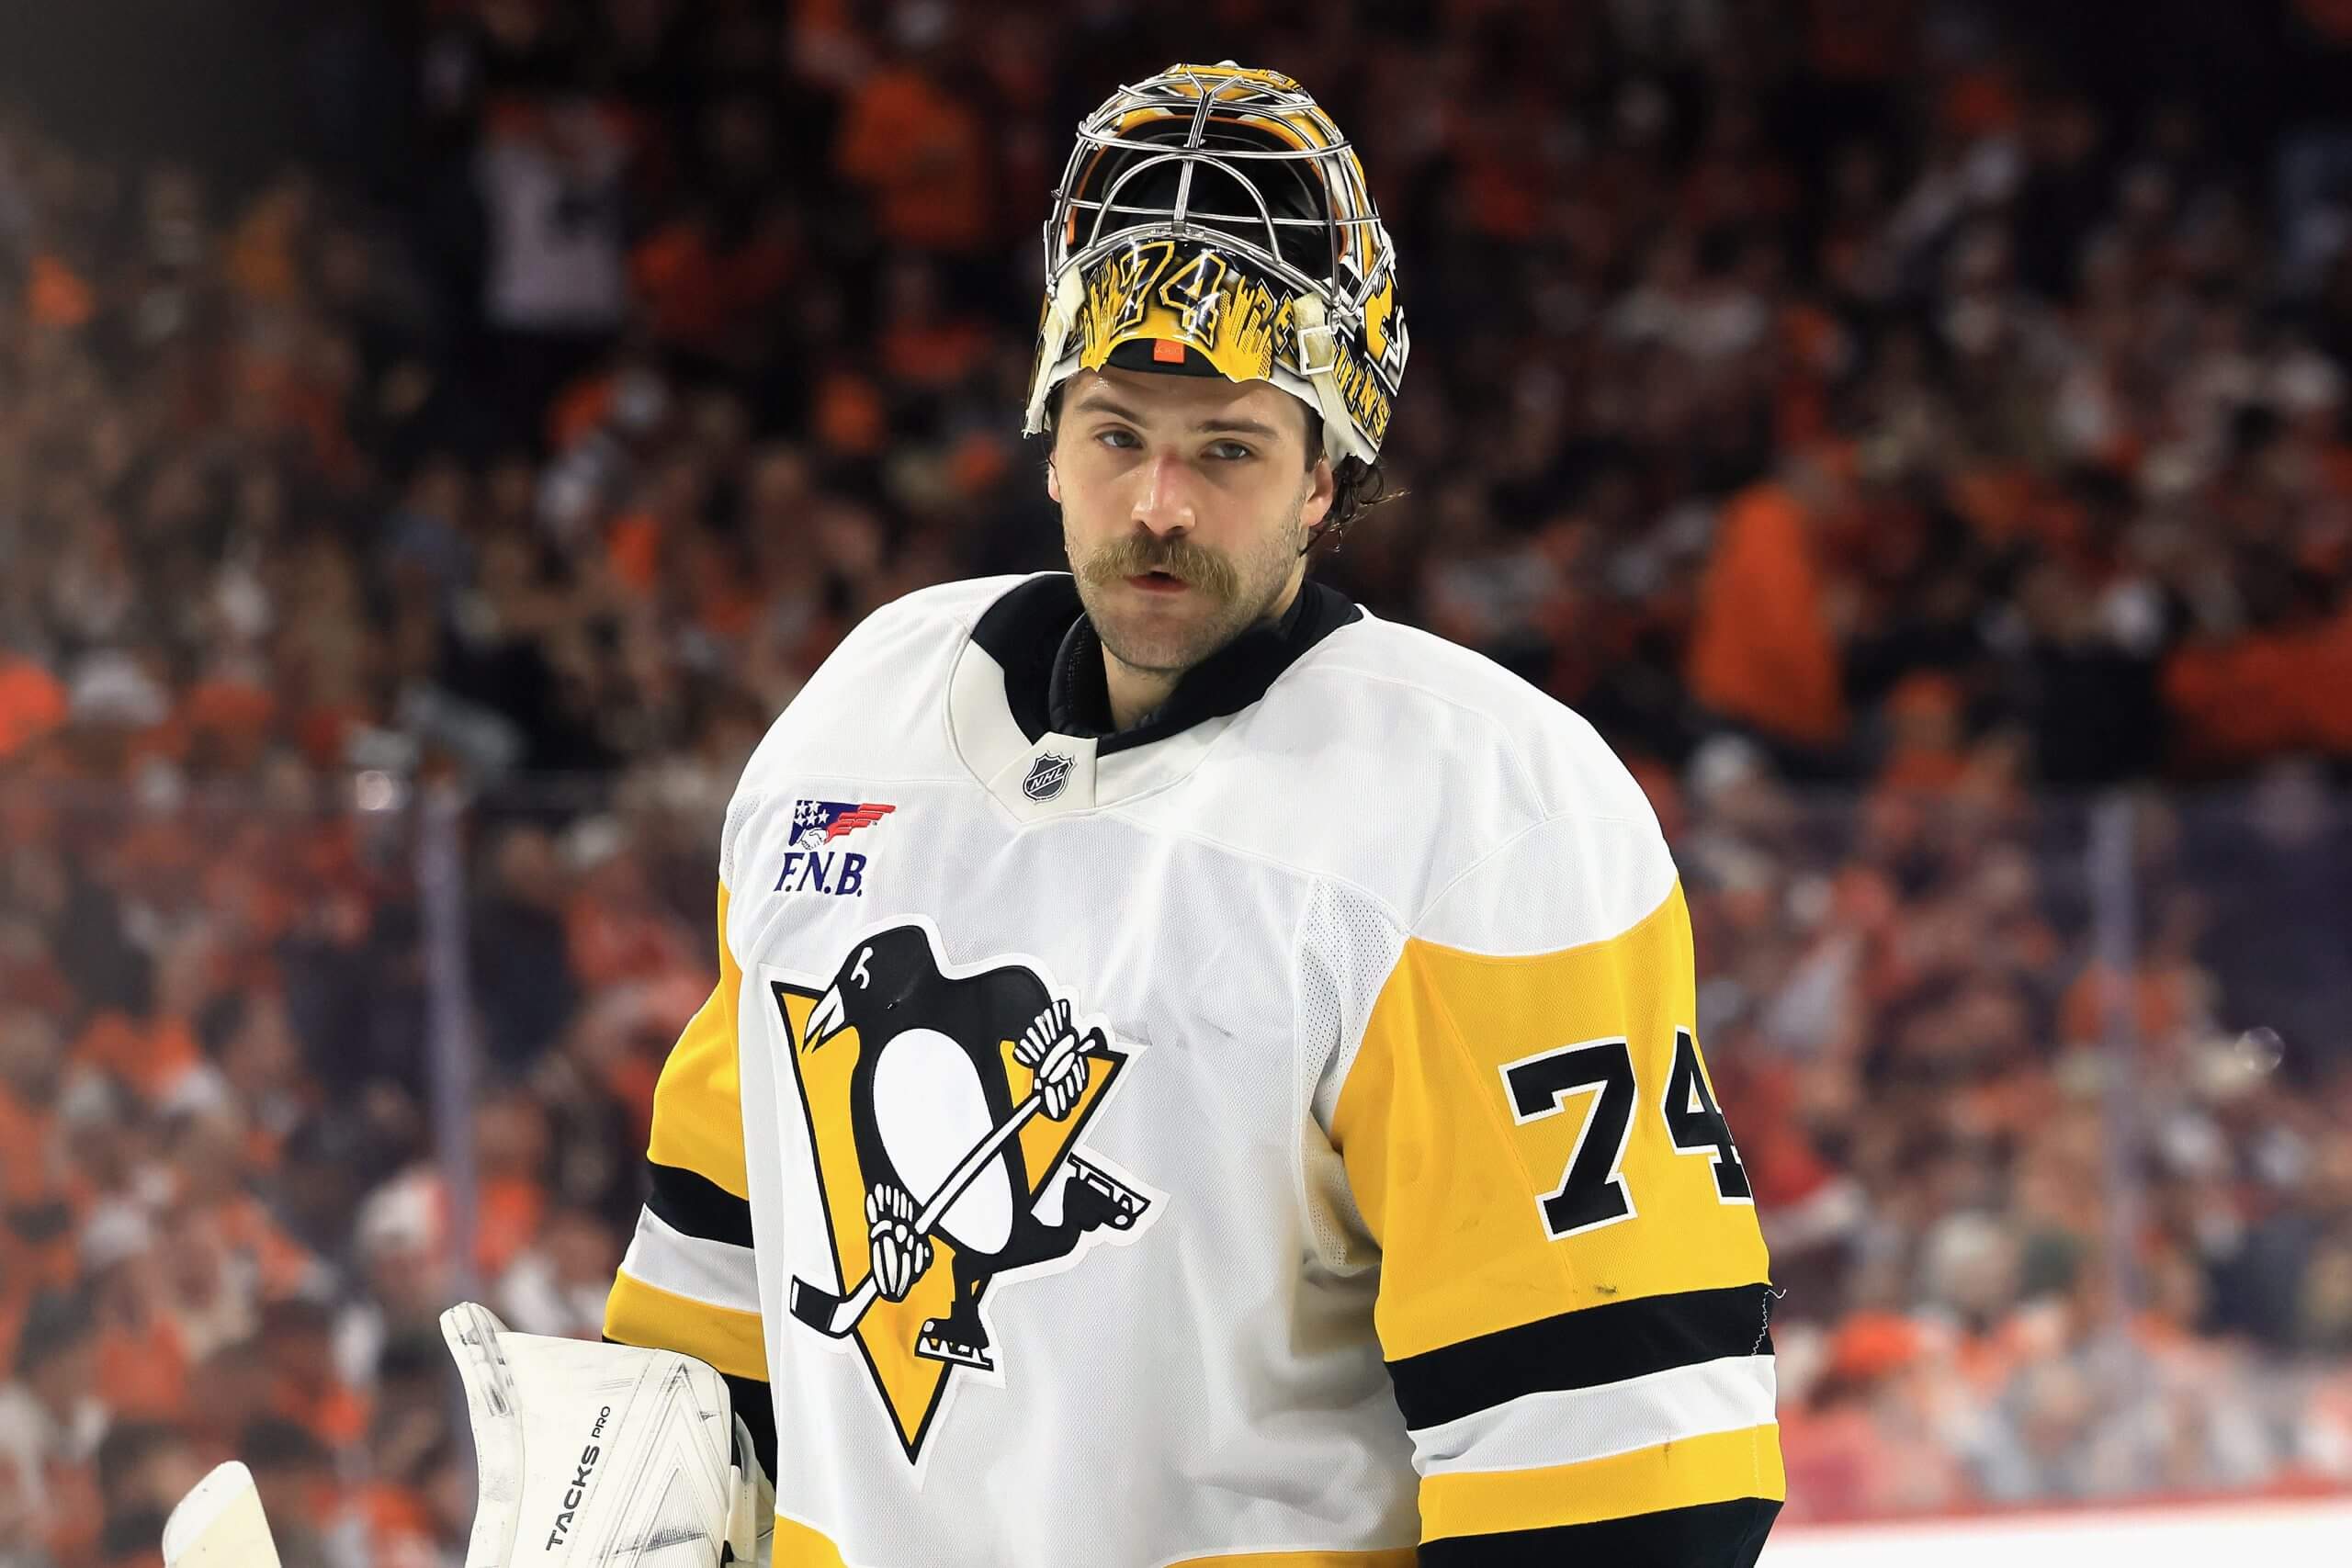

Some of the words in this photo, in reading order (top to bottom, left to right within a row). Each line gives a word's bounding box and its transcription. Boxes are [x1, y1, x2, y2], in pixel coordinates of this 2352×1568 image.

[1112, 241, 1227, 349] 74
[1029, 767, 1063, 790] NHL
[774, 852, 866, 897] F.N.B.
[1498, 1024, 1754, 1243] 74
[546, 1444, 601, 1551] TACKS
[591, 1405, 611, 1438] PRO
